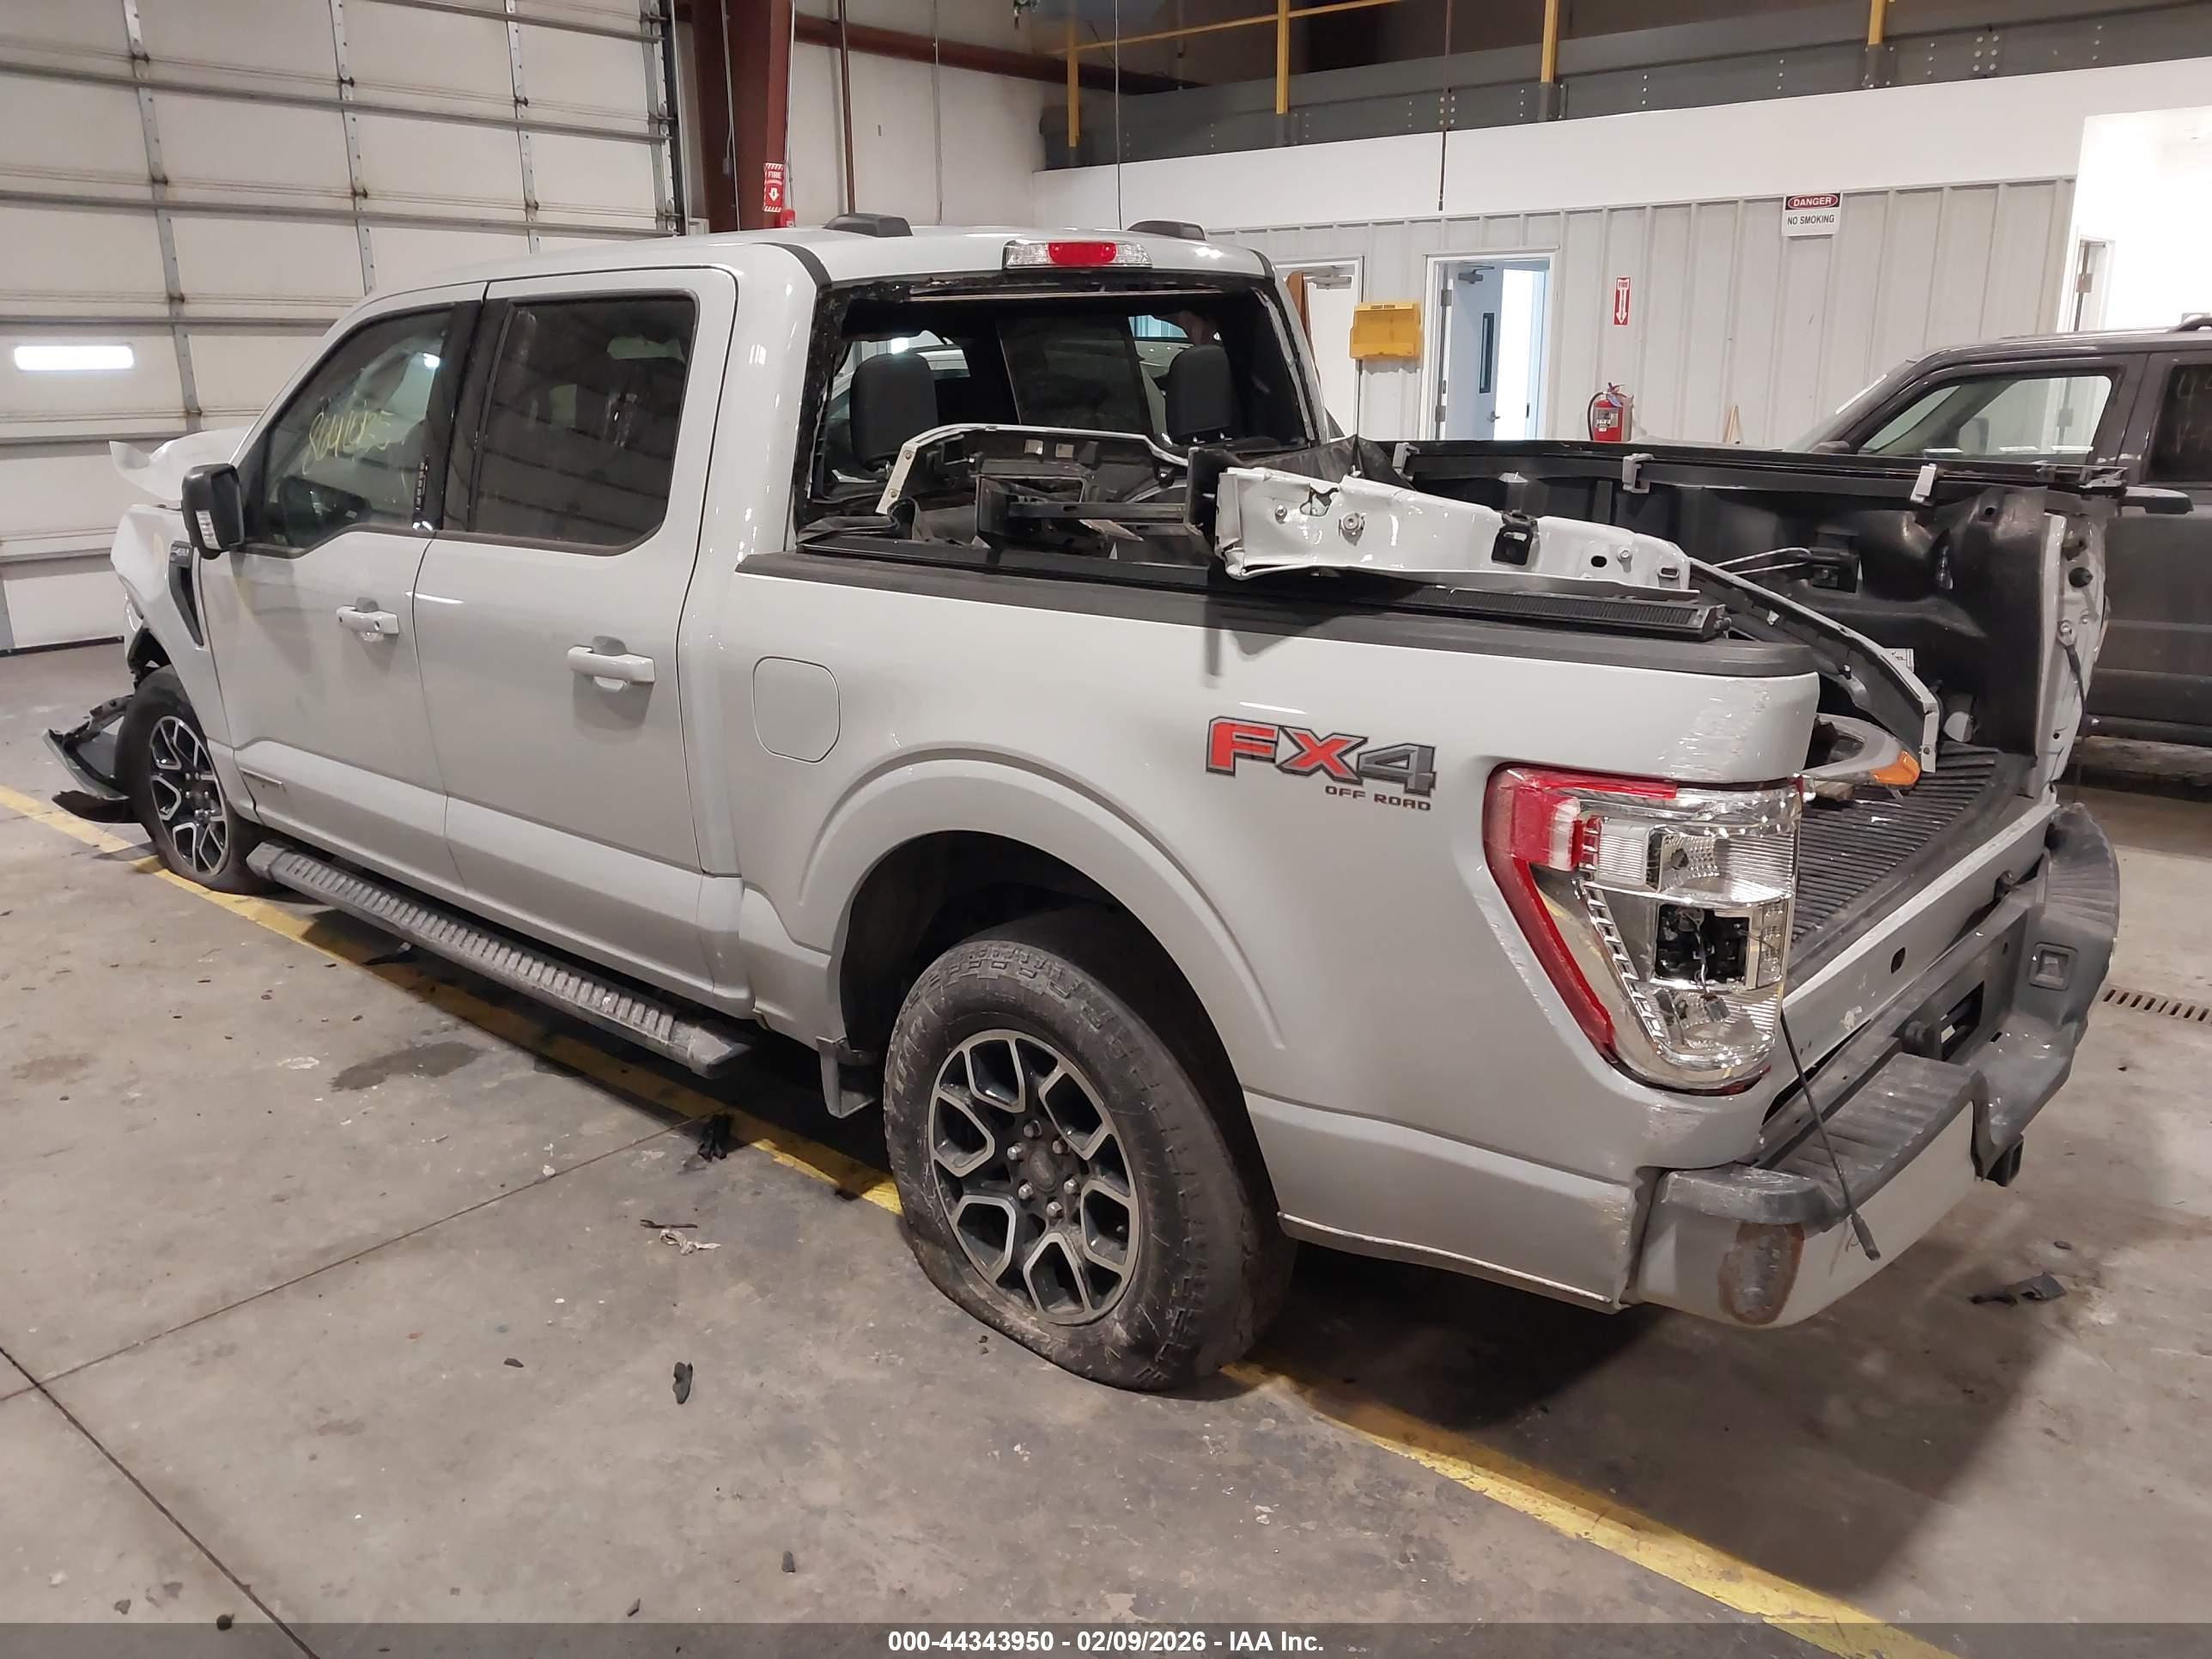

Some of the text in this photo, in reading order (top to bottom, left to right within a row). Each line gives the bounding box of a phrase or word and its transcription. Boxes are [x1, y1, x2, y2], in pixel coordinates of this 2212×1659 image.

[1793, 197, 1832, 207] DANGER
[1787, 214, 1835, 225] NO SMOKING
[1206, 716, 1436, 797] FX4
[1325, 785, 1431, 811] OFF ROAD
